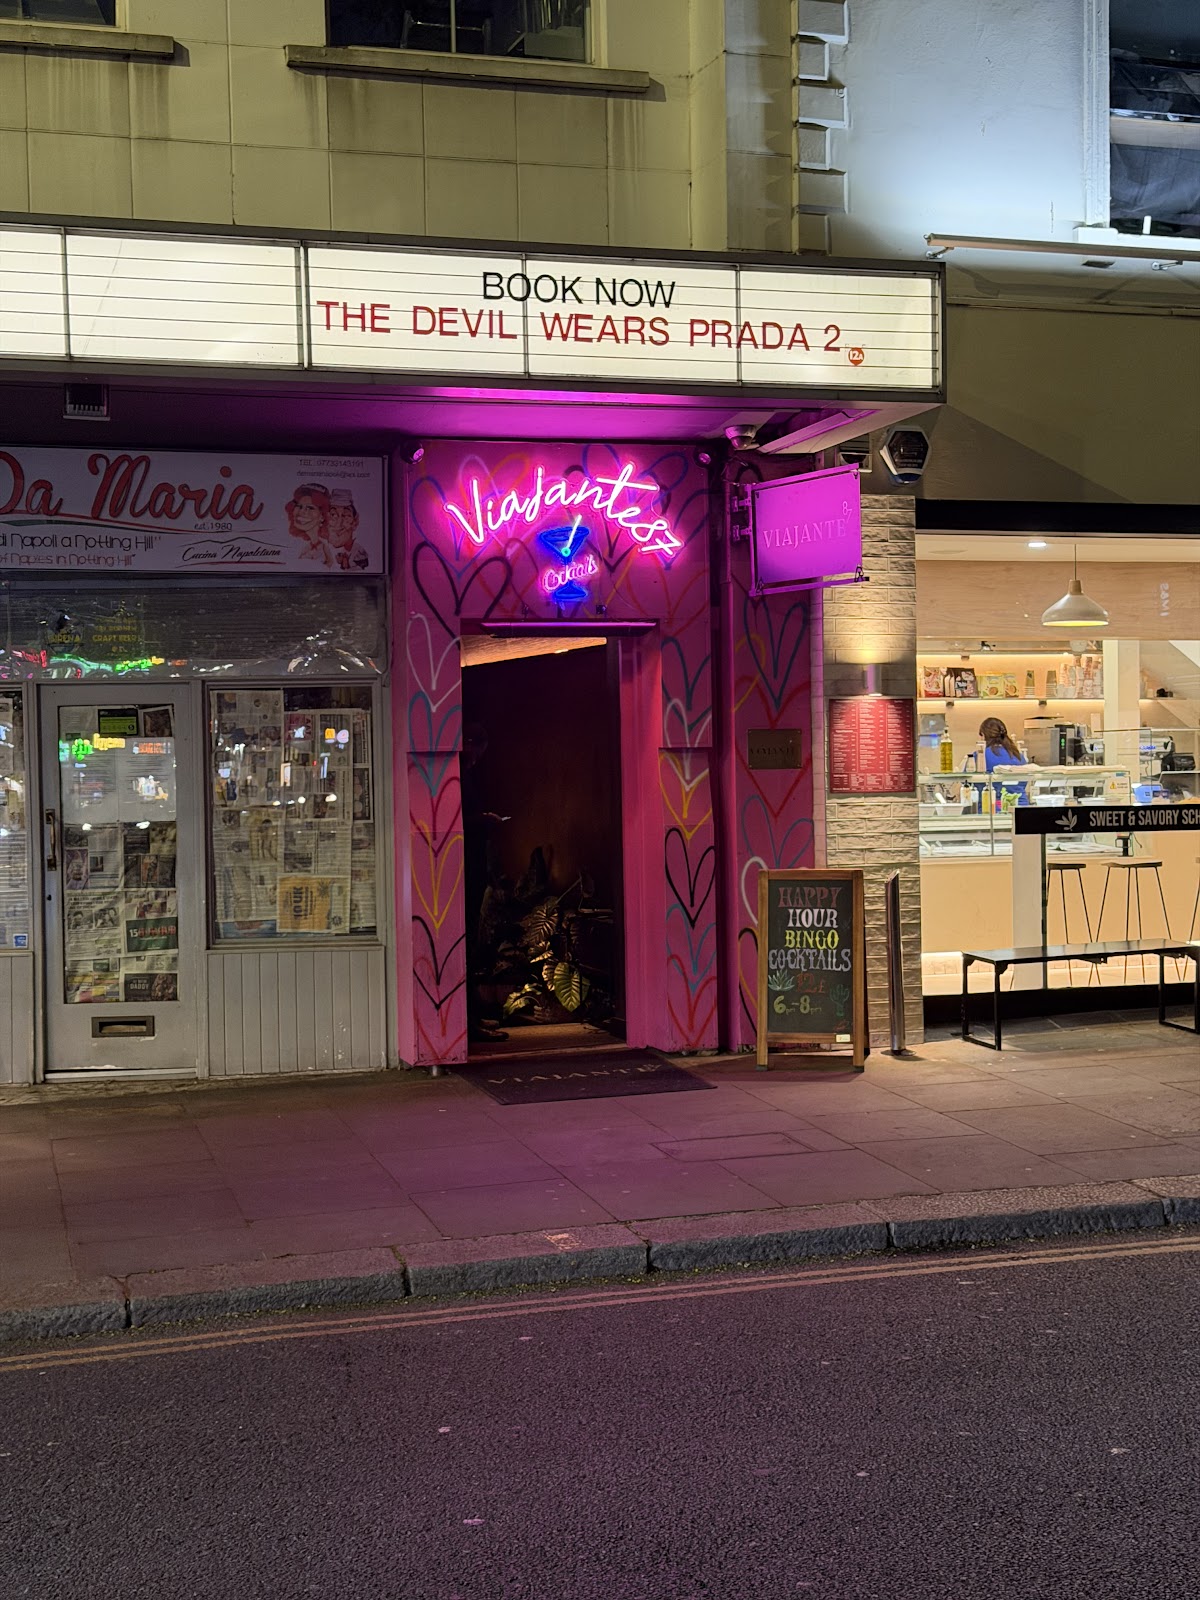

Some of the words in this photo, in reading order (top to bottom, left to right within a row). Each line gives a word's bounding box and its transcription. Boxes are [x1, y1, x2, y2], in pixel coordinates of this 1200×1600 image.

[483, 271, 583, 304] BOOK
[595, 277, 676, 309] NOW
[317, 300, 390, 334] THE
[412, 305, 518, 340] DEVIL
[540, 312, 670, 346] WEARS
[689, 319, 811, 353] PRADA
[824, 324, 842, 353] 2
[849, 350, 864, 361] 12A
[87, 453, 264, 521] Maria
[11, 533, 58, 550] Napoli
[61, 536, 72, 547] a
[75, 534, 131, 552] Notting
[762, 518, 847, 549] VIAJANTE
[69, 553, 115, 567] Notting
[182, 546, 218, 562] Cucina
[543, 554, 598, 593] Cocktails
[1089, 810, 1126, 827] SWEET
[1128, 810, 1136, 826] &
[1138, 809, 1180, 826] SAVORY
[1181, 808, 1200, 825] SCH
[778, 886, 843, 908] HAPPY
[787, 908, 839, 928] HOUR
[784, 929, 840, 950] BINGO
[768, 948, 852, 972] COCKTAILS
